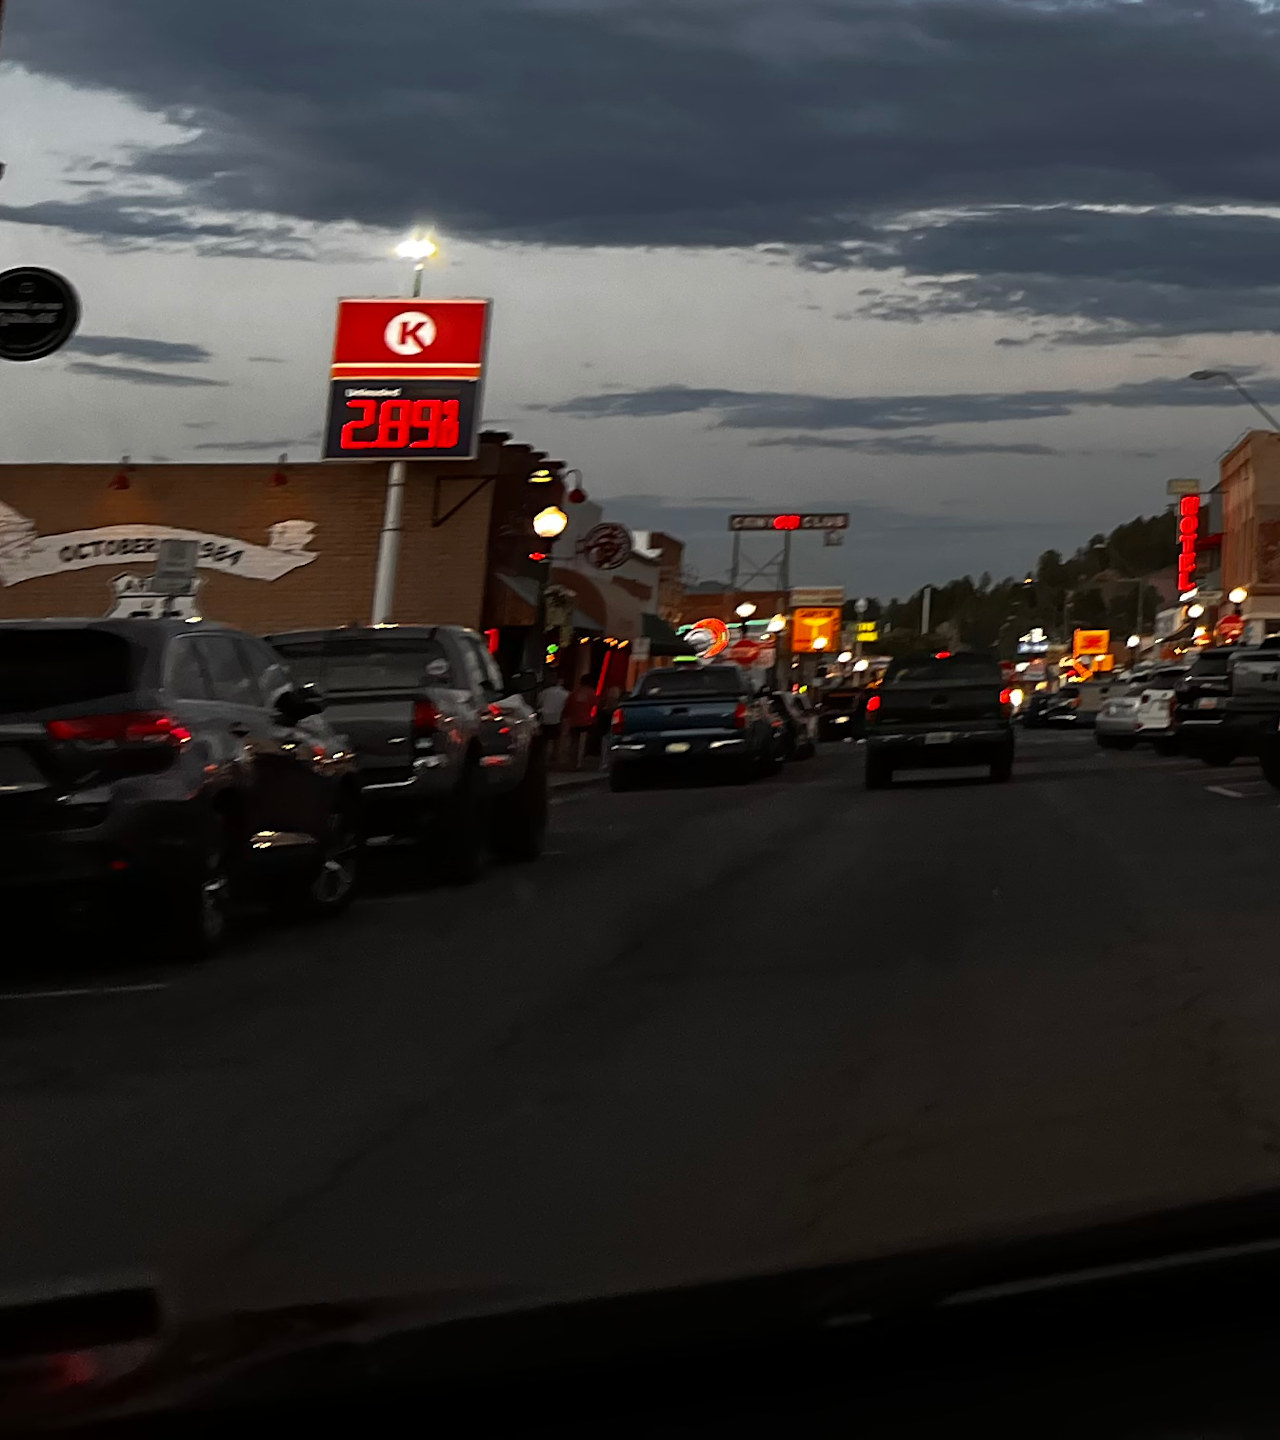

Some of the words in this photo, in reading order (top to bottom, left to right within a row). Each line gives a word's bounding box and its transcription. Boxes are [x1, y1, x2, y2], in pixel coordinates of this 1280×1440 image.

[399, 321, 427, 349] K
[58, 538, 160, 563] OCTOBER
[199, 541, 245, 567] 984
